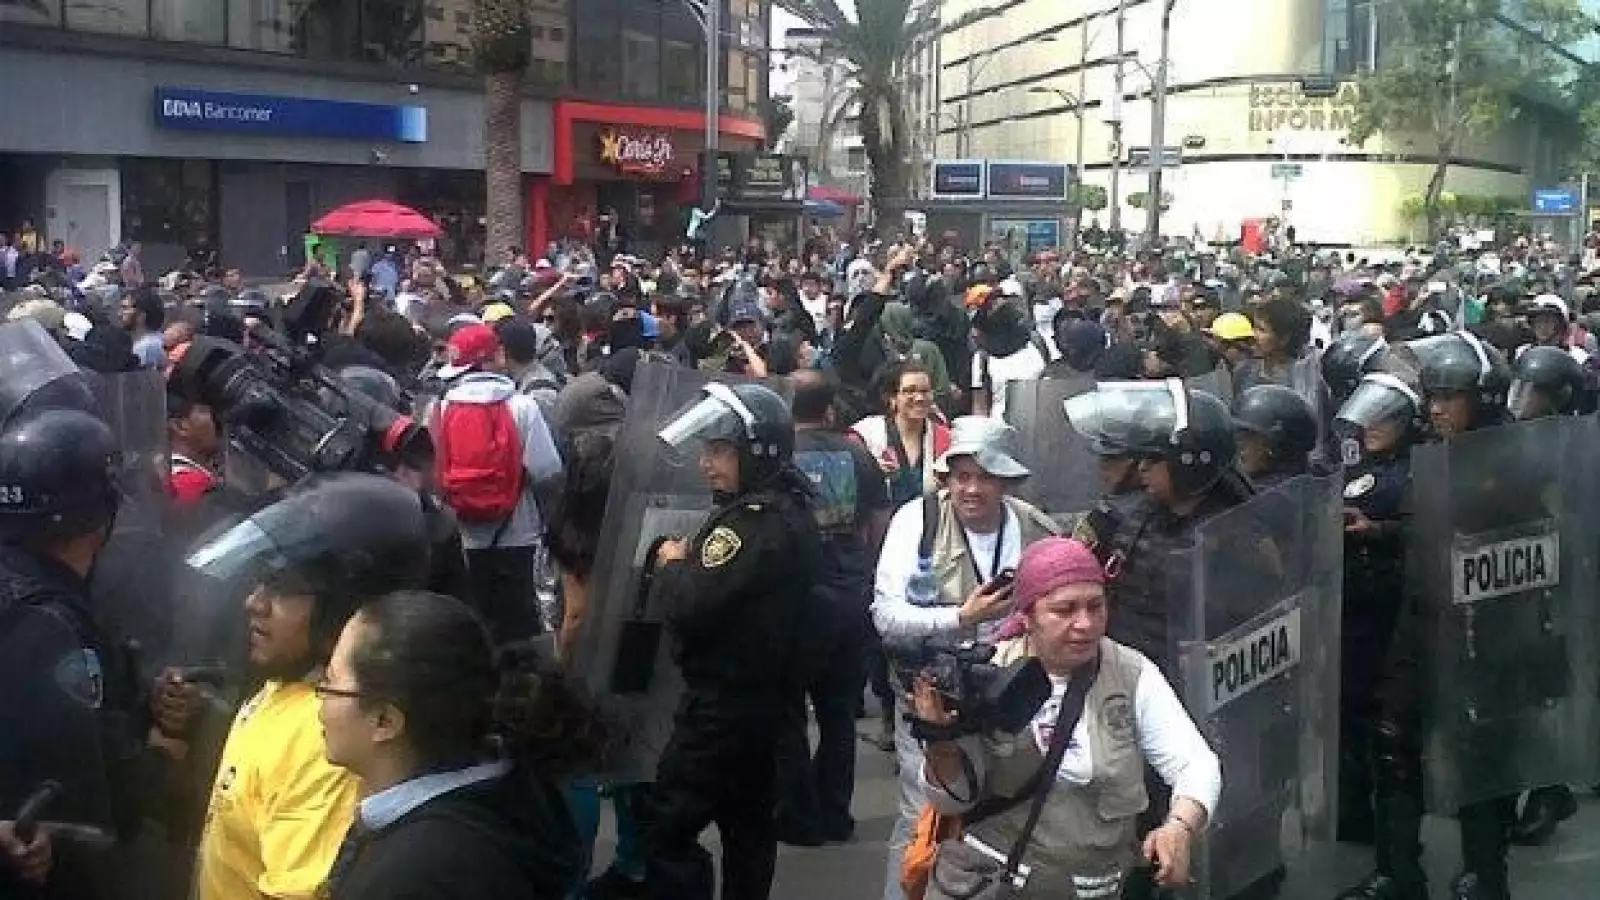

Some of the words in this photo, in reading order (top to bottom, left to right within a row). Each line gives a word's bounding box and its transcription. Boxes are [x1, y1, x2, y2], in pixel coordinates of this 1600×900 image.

[163, 99, 201, 117] BBVA
[204, 102, 272, 121] Bancomer
[1463, 543, 1546, 596] POLICIA
[1212, 625, 1288, 701] POLICIA
